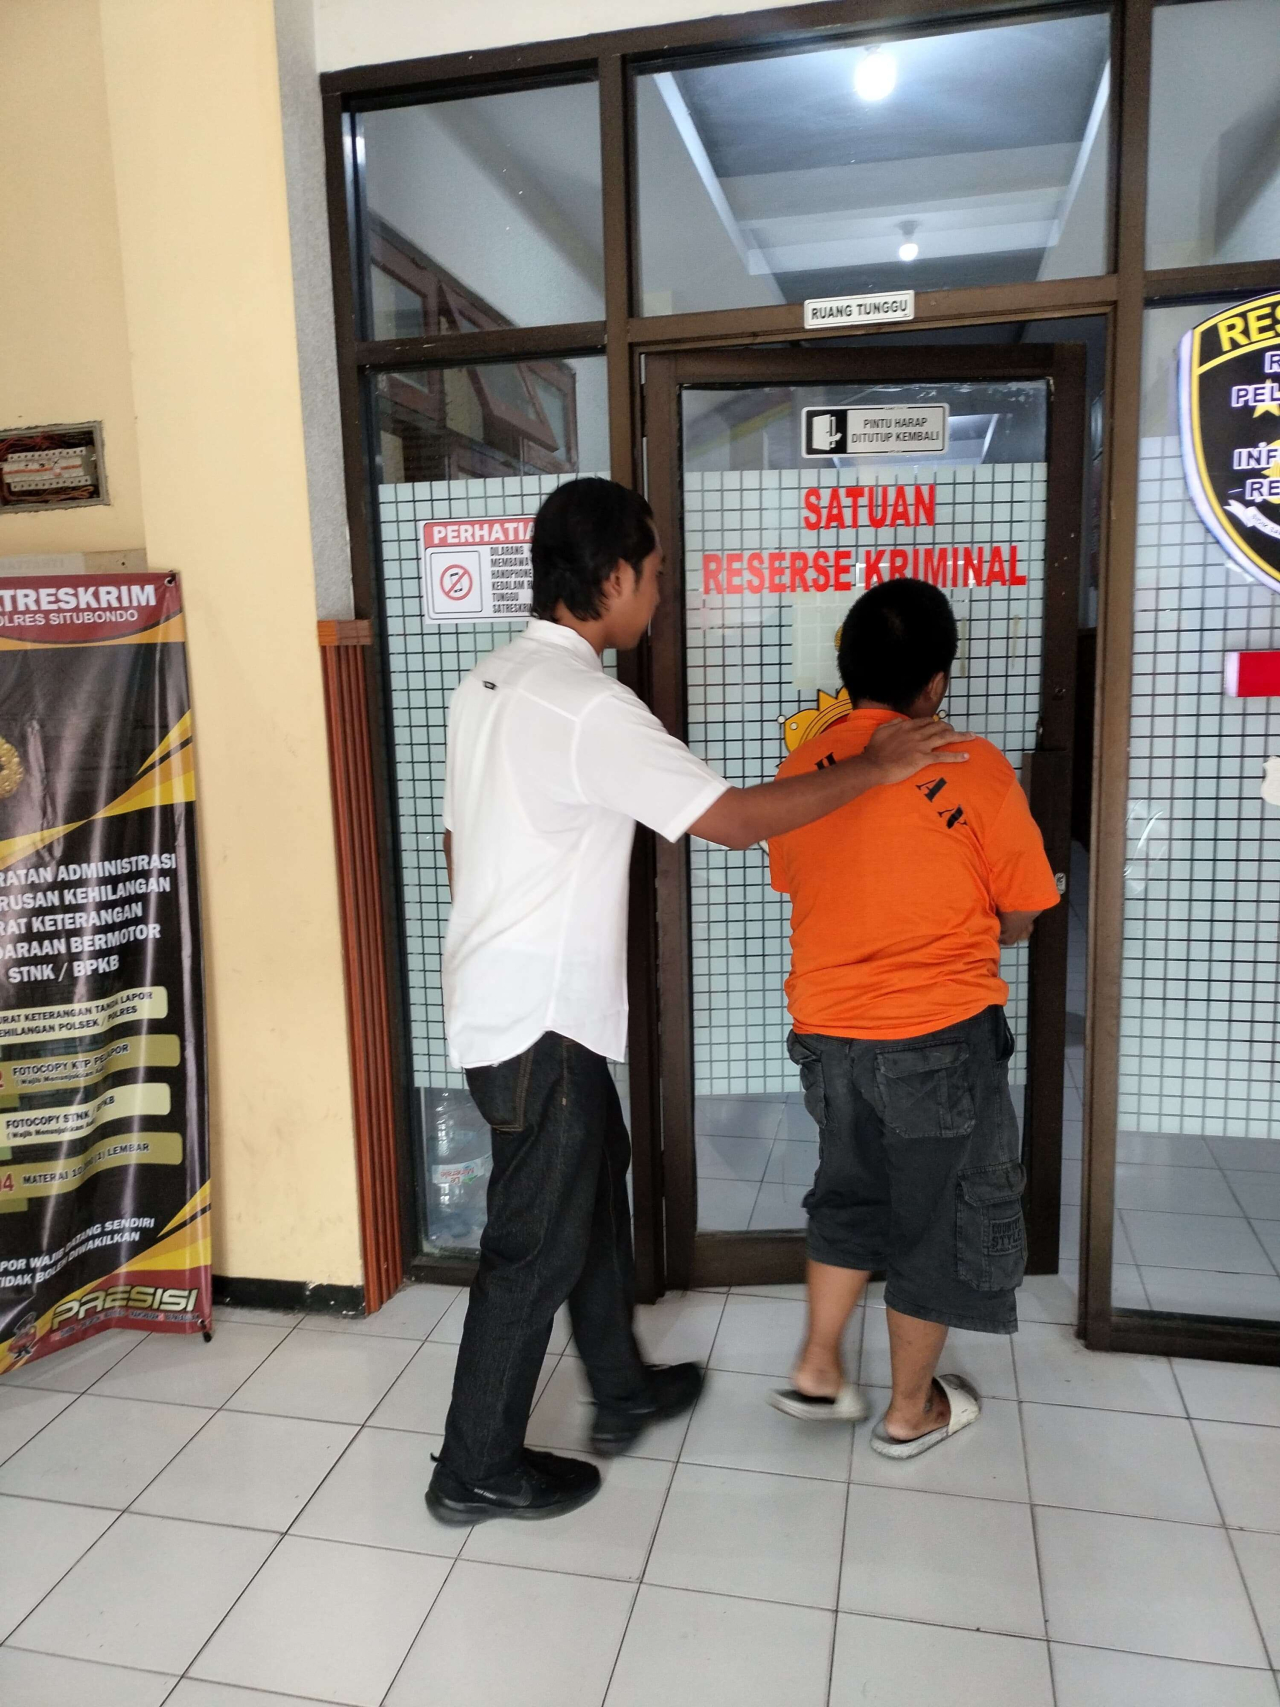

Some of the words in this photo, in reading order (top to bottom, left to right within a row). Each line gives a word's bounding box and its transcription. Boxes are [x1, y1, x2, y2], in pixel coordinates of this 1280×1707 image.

[811, 304, 853, 320] RUANG
[857, 299, 908, 316] TUNGGU
[1217, 306, 1280, 352] RE
[851, 432, 894, 443] DITUTUP
[895, 430, 940, 442] KEMBALI
[863, 418, 892, 429] PINTU
[894, 417, 928, 428] HARAP
[803, 484, 936, 531] SATUAN
[432, 522, 534, 544] PERHATIA
[490, 545, 524, 557] DILARANG
[490, 557, 529, 568] MEMBAWA
[703, 550, 852, 595] RESERSE
[864, 545, 1027, 591] KRIMINAL
[0, 585, 156, 612] TRESKRIM
[49, 609, 138, 625] SITUBONDO
[57, 853, 176, 882] ADMINISTRASI
[63, 877, 171, 905] KEHILANGAN
[32, 902, 143, 933] KETERANGAN
[70, 924, 161, 952] BERMOTOR
[8, 962, 55, 984] STNK
[73, 954, 120, 978] BPKB
[24, 1007, 92, 1023] KETERANGAN
[120, 992, 153, 1004] LAPOR
[58, 1018, 99, 1032] POLSEK
[12, 1061, 69, 1077] FOTOCOPY
[6, 1115, 61, 1131] FOTOCOPY
[0, 1173, 14, 1192] 4
[22, 1171, 69, 1185] MATERAI
[107, 1142, 149, 1157] LEMBAR
[104, 1217, 155, 1231] SENDIRI
[68, 1231, 140, 1260] DIWAKILKAN
